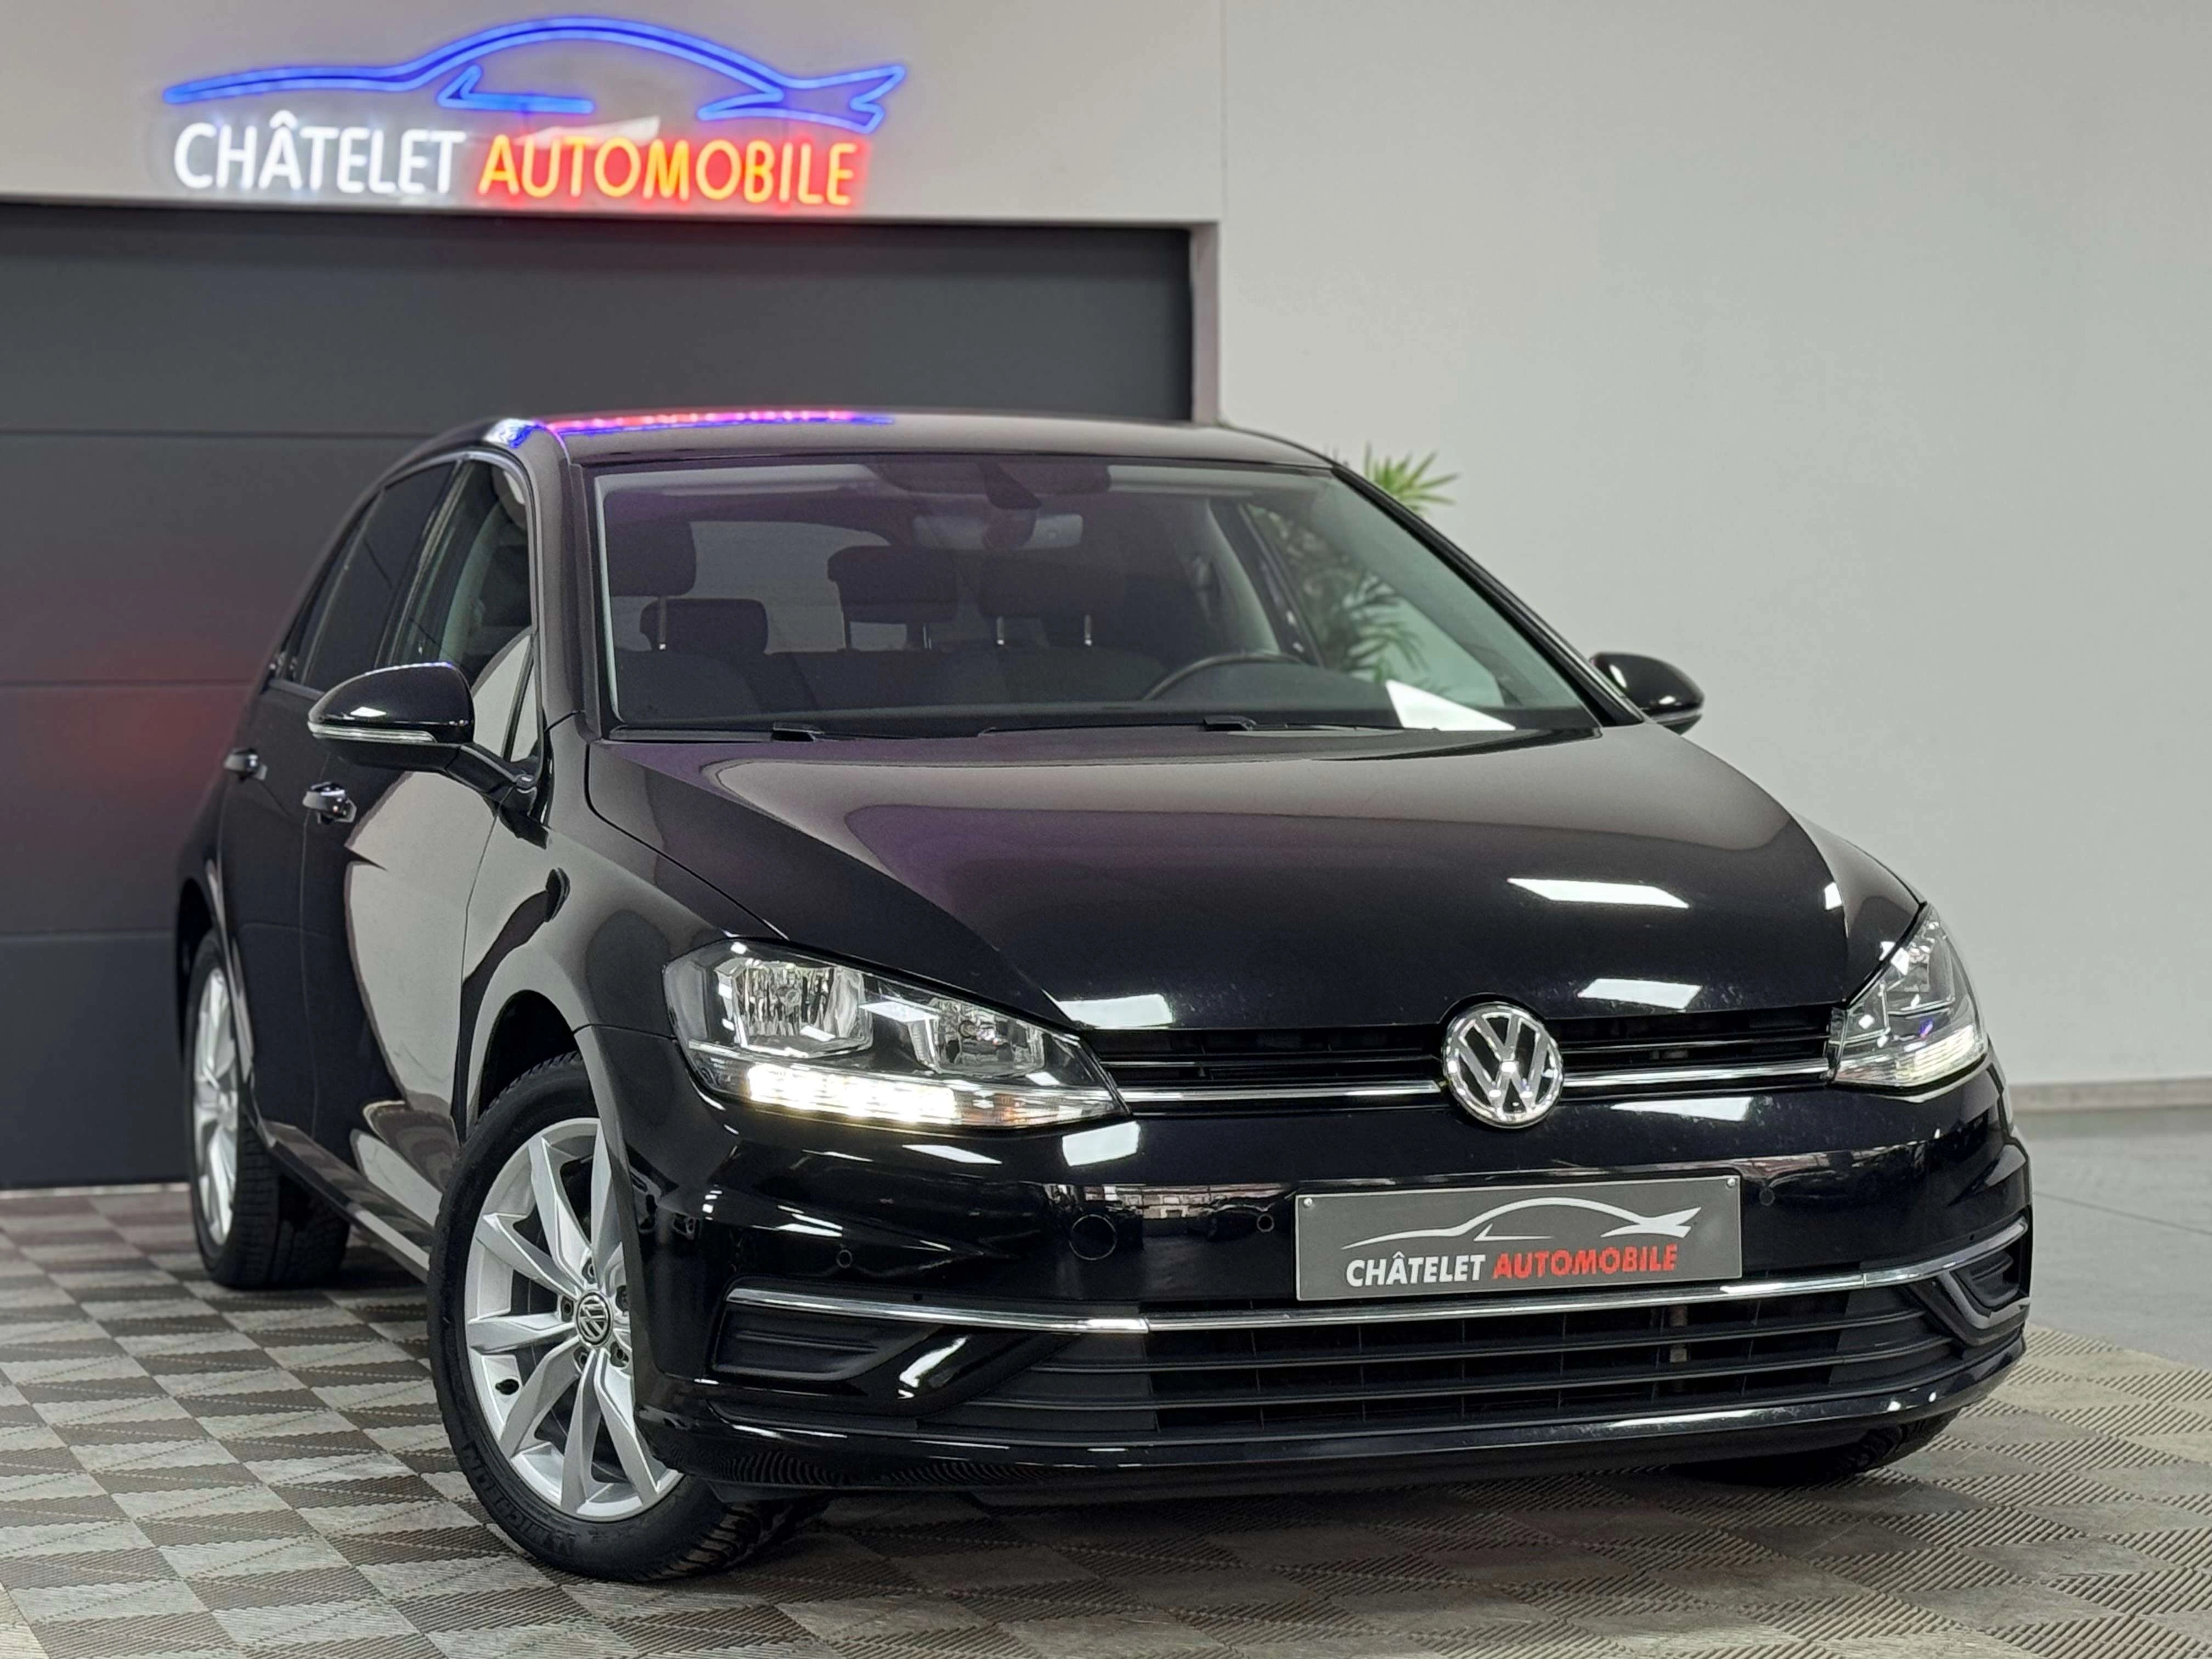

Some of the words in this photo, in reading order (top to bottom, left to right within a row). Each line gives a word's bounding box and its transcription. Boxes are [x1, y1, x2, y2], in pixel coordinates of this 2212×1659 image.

[173, 110, 467, 194] CHÂTELET
[477, 134, 858, 205] AUTOMOBILE
[1346, 1251, 1486, 1287] CHÂTELET
[1492, 1244, 1679, 1280] AUTOMOBILE
[462, 1444, 549, 1544] MICHELIN
